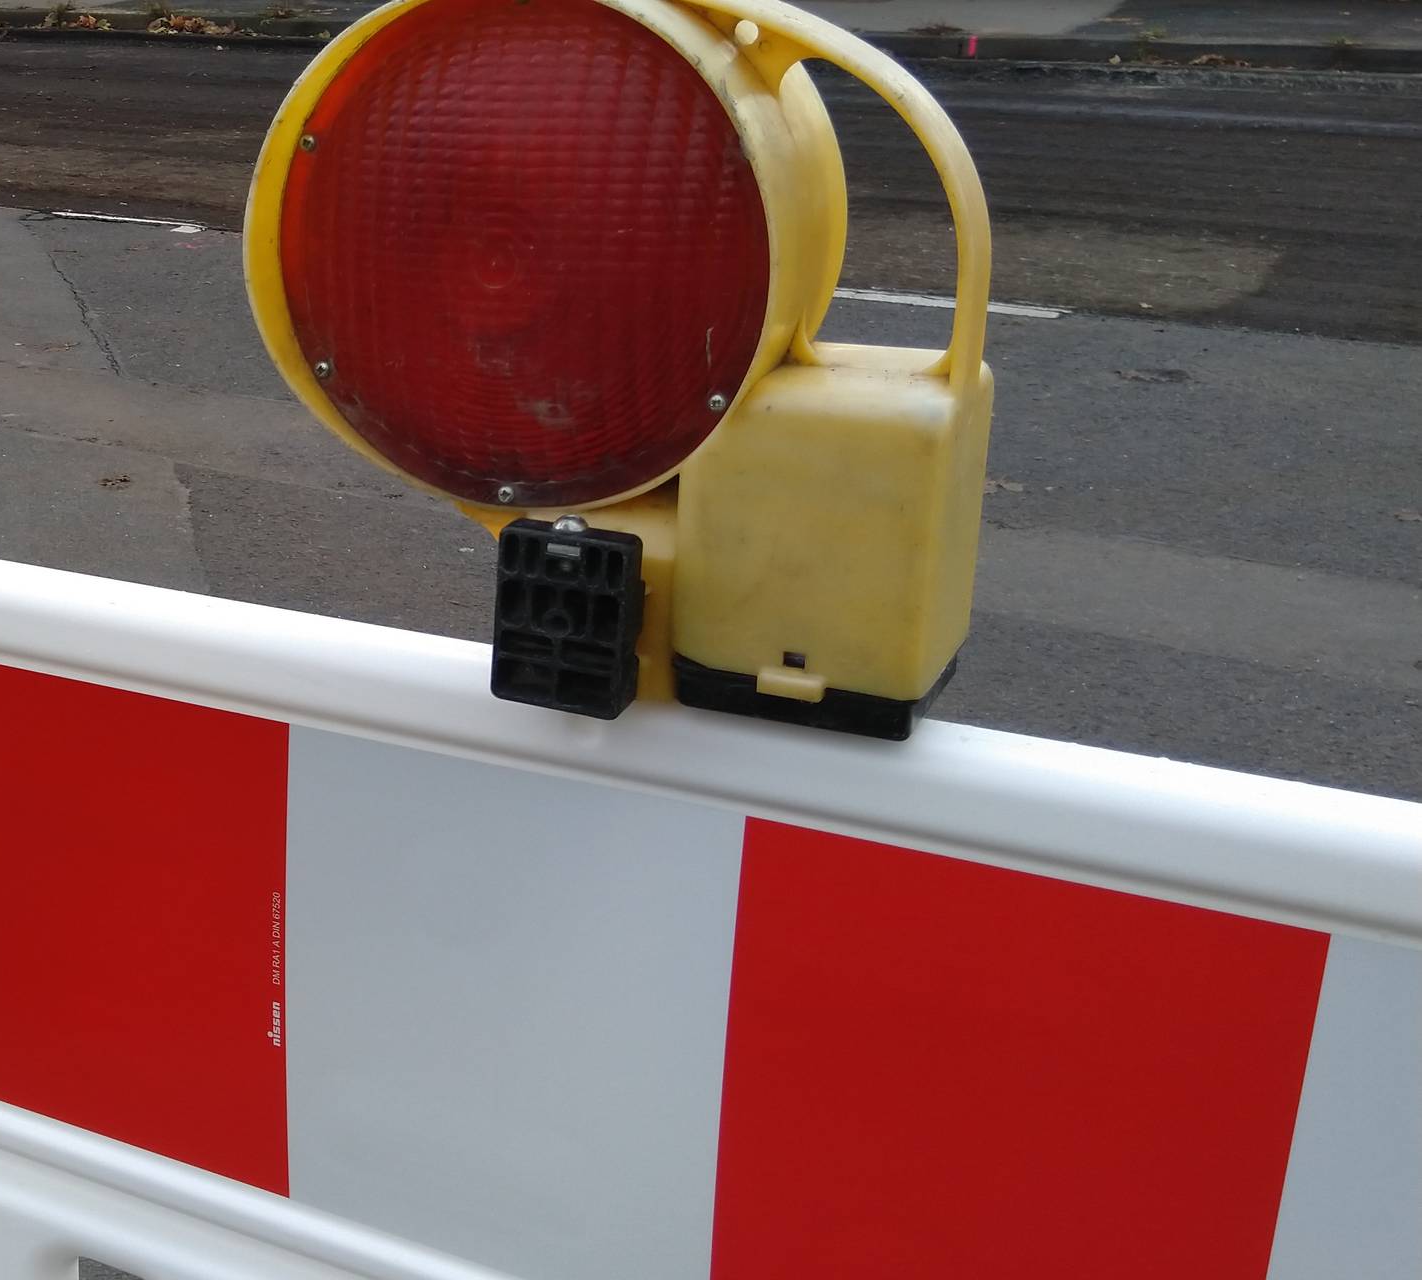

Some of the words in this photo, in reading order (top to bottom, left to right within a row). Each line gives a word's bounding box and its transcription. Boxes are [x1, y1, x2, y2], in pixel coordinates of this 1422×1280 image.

[272, 891, 281, 919] 67520
[272, 921, 281, 939] DIN
[272, 950, 281, 968] RA1
[272, 969, 281, 985] DM
[267, 1001, 281, 1047] nissen
